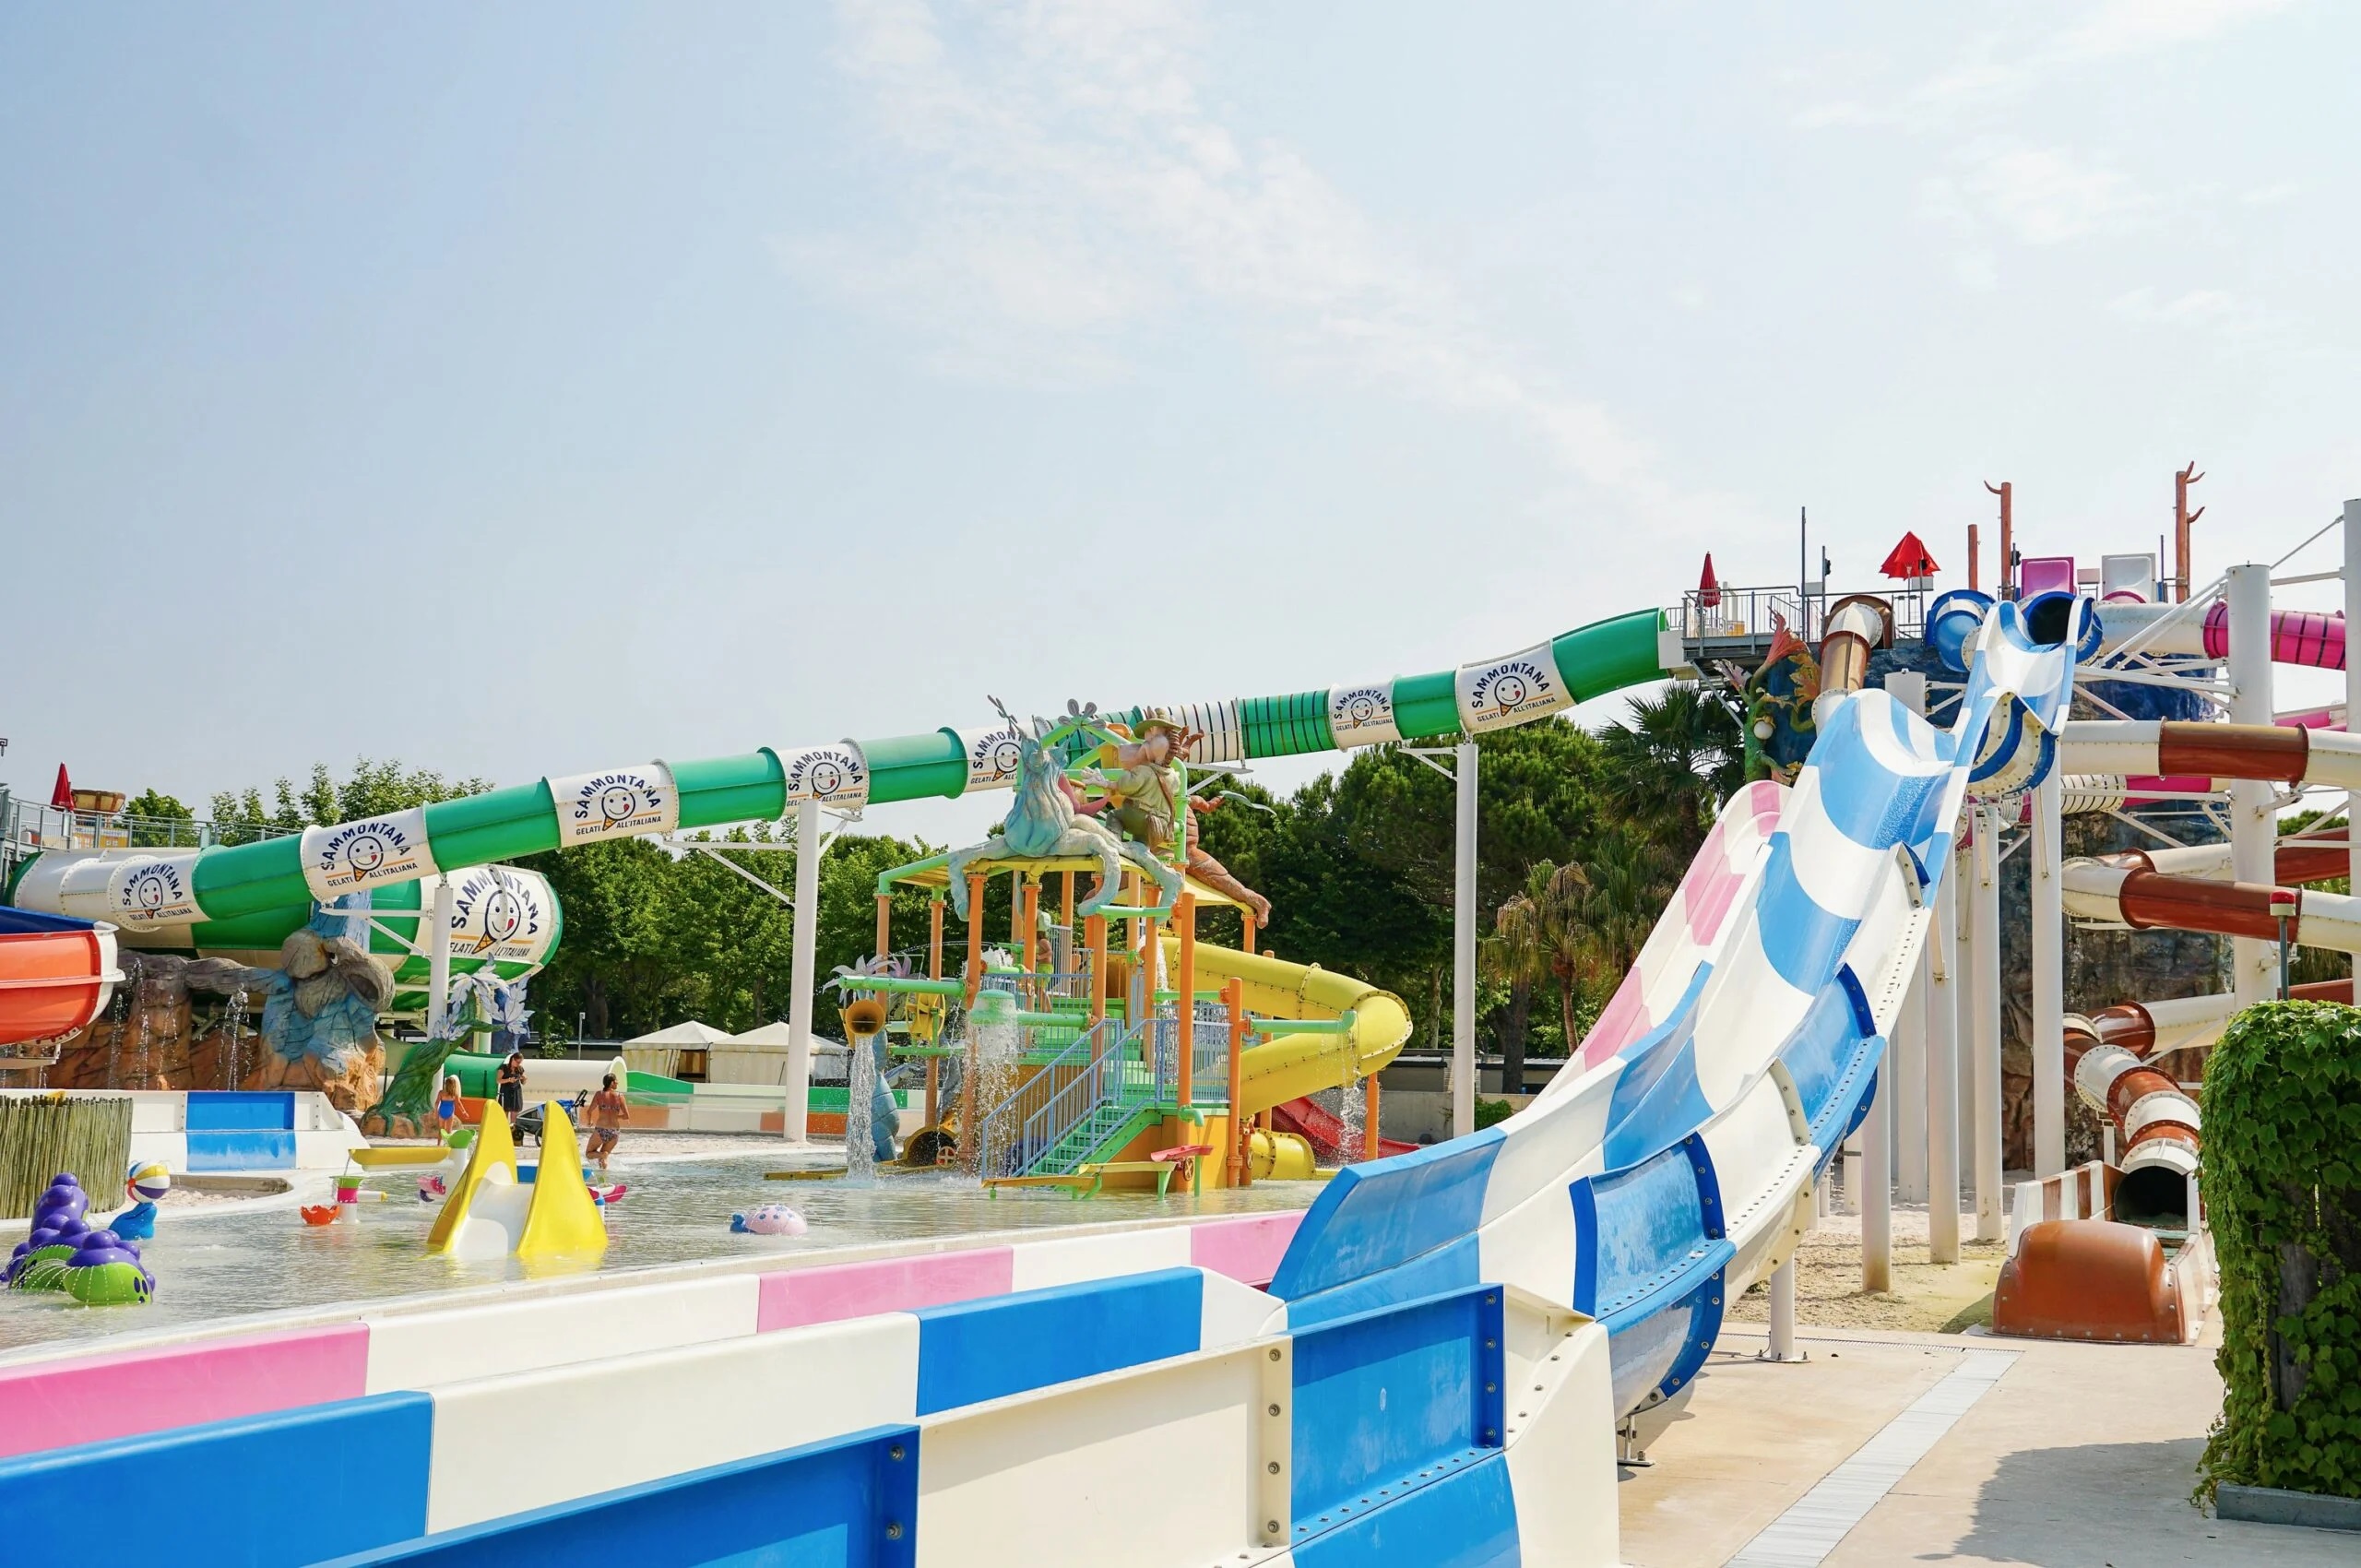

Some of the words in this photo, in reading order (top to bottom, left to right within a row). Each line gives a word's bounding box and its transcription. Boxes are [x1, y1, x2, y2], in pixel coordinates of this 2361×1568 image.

[1471, 662, 1550, 708] SAMMONTANA
[1334, 689, 1391, 719] SAMMONTANA
[1477, 712, 1500, 722] GELATI
[1513, 696, 1557, 714] ALL'ITALIANA
[1362, 718, 1394, 727] ALL'ITALIANA
[788, 751, 864, 791] SAMMONTANA
[970, 776, 991, 785] GELATI
[575, 774, 661, 819] SAMMONTANA
[821, 791, 862, 802] ALL'ITALIANA
[575, 826, 600, 836] GELATI
[616, 815, 662, 829] ALL'ITALIANA
[320, 823, 411, 871] SAMMONTANA
[122, 863, 184, 907] SAMMONTANA
[327, 876, 353, 887] GELATI
[369, 862, 419, 879] ALL'ITALIANA
[156, 908, 194, 919] ALL'ITALIANA
[449, 942, 472, 954] ELATI
